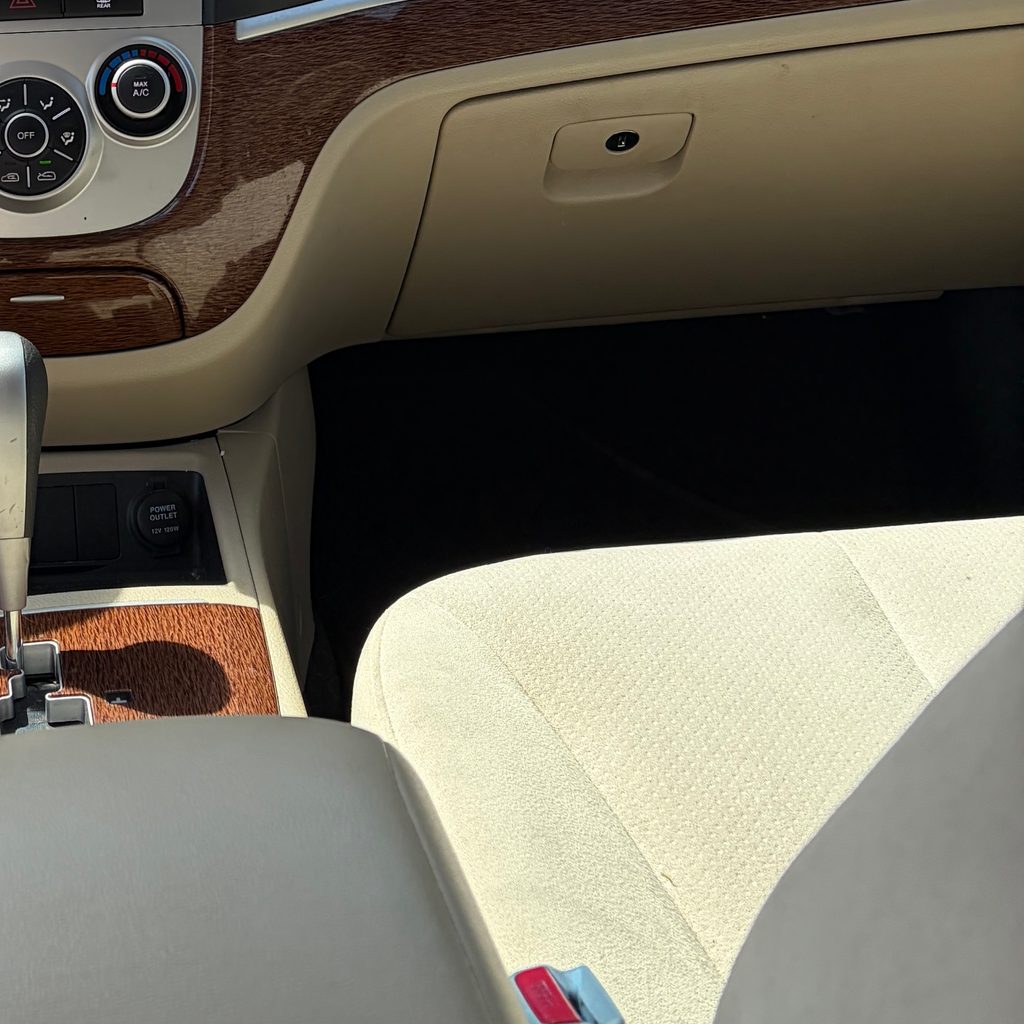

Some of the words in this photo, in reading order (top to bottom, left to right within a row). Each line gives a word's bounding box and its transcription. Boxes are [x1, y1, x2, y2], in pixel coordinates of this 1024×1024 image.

[96, 1, 111, 9] REAR
[133, 88, 150, 97] A/C
[16, 131, 35, 140] OFF
[149, 504, 176, 513] POWER
[149, 512, 178, 521] OUTLET
